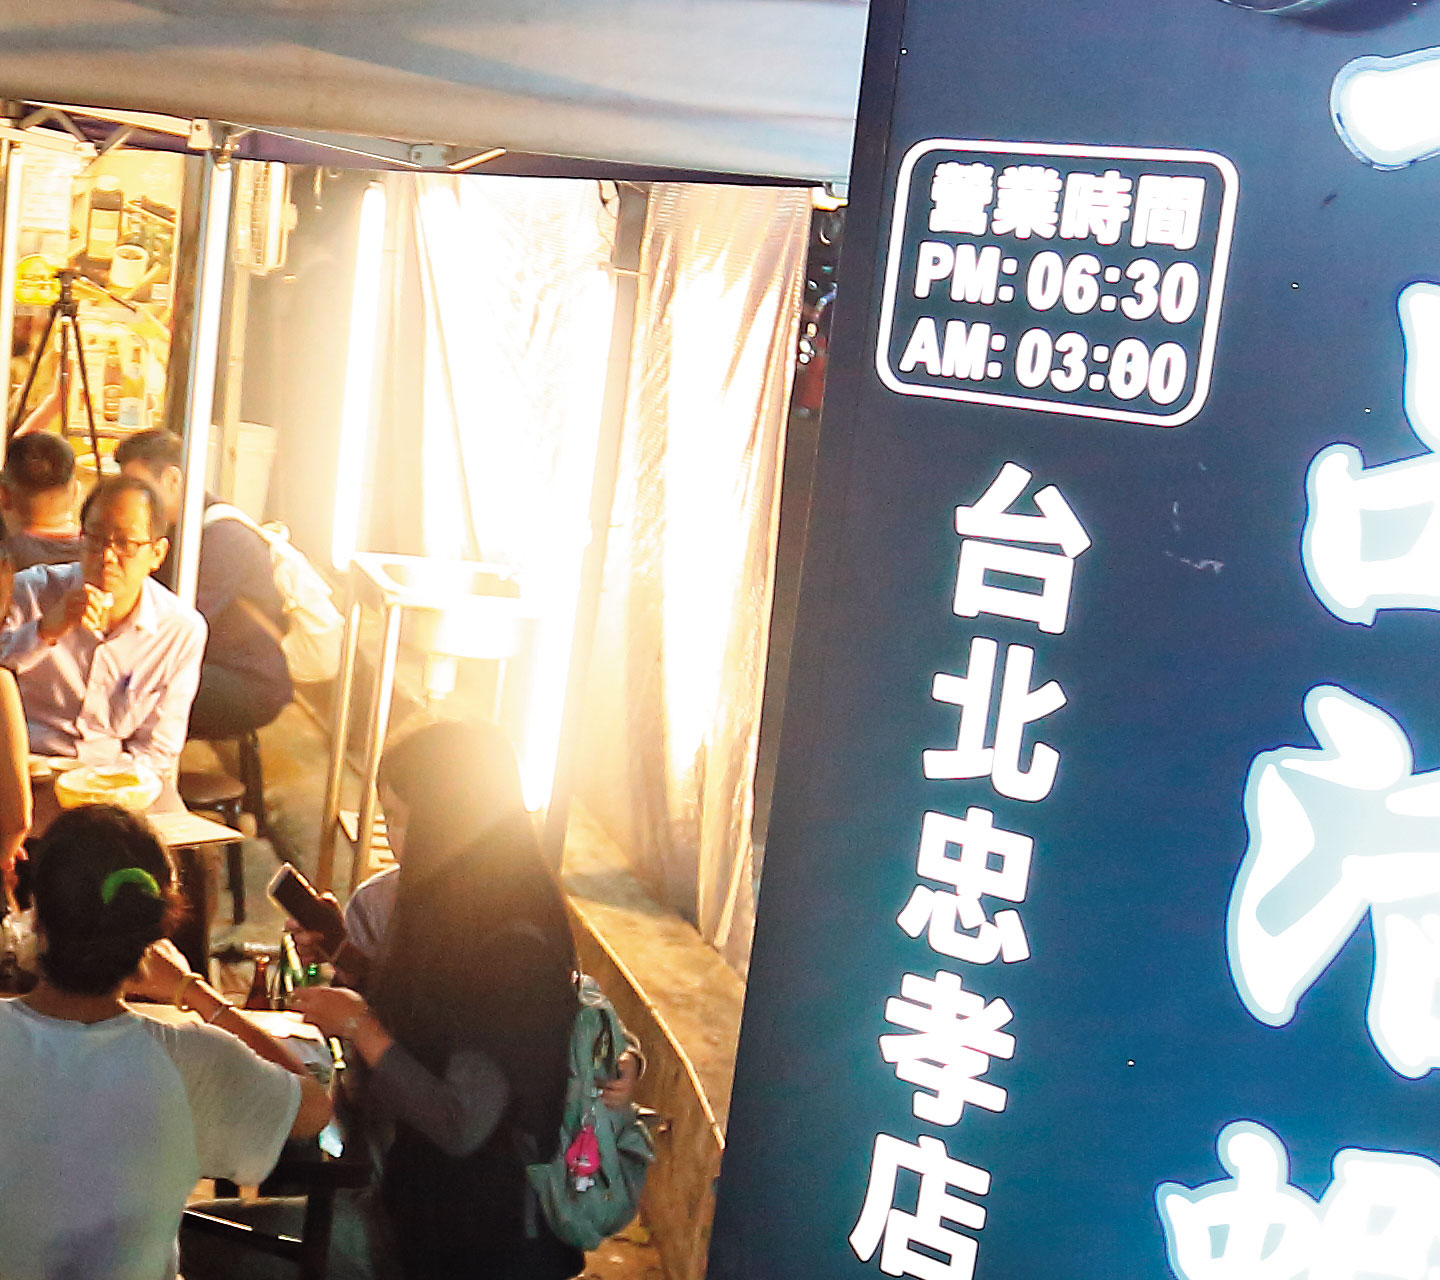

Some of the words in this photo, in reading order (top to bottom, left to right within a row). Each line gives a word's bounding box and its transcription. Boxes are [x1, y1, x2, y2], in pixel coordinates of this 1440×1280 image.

[928, 161, 1207, 250] 營業時間
[913, 240, 1018, 305] PM:
[1026, 250, 1200, 324] 06:30
[898, 316, 1007, 381] AM:
[1015, 327, 1188, 405] 03:00
